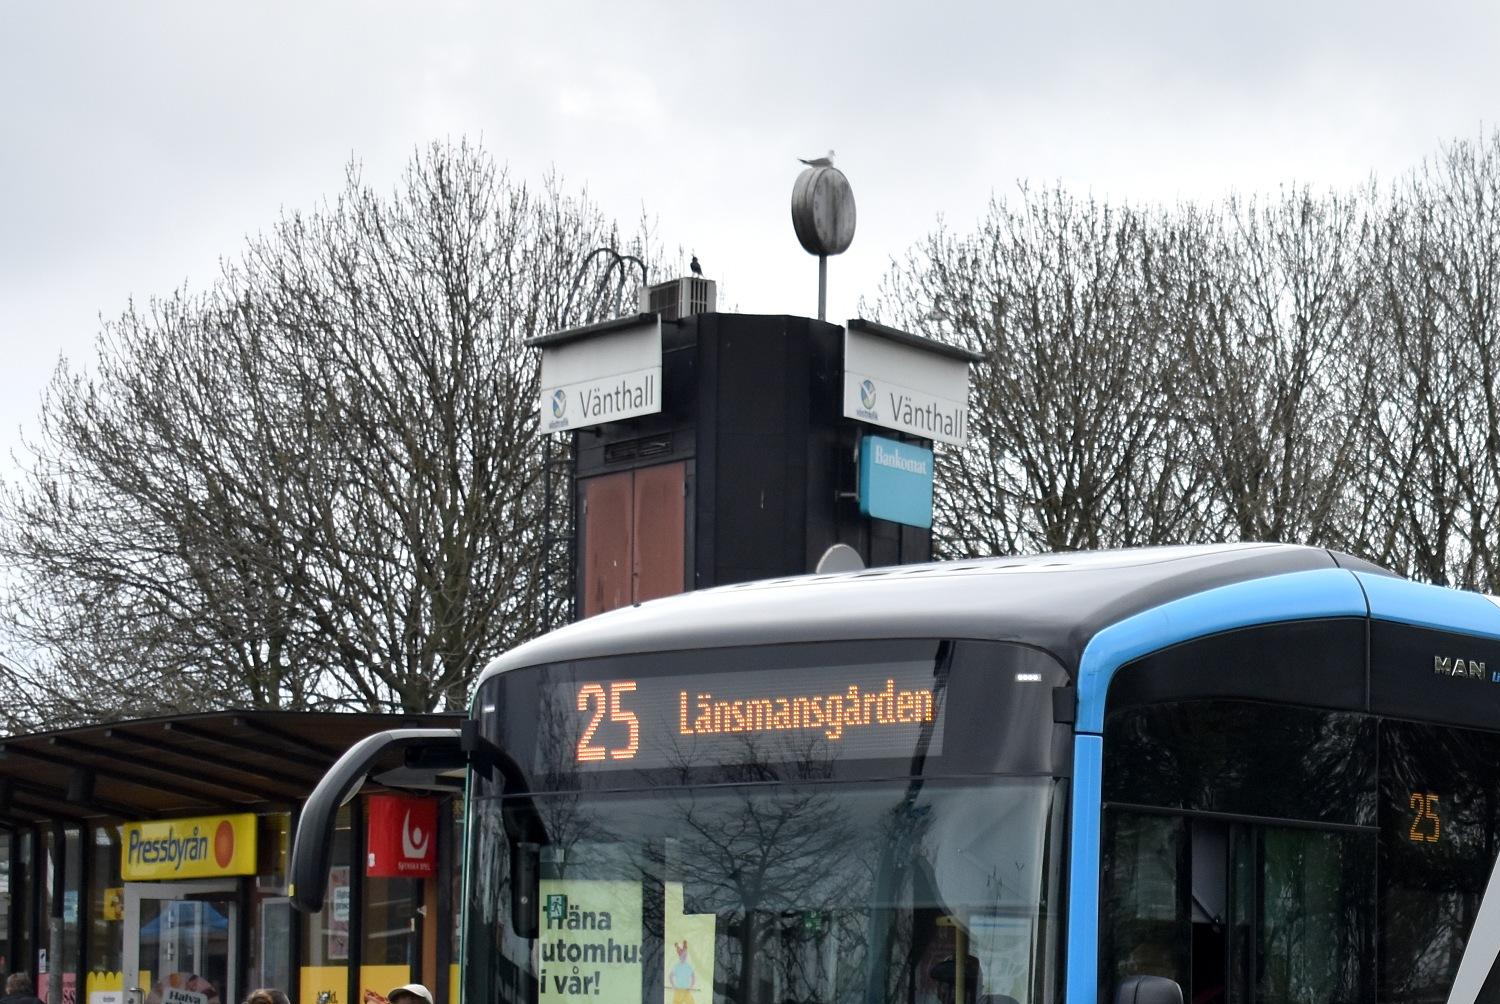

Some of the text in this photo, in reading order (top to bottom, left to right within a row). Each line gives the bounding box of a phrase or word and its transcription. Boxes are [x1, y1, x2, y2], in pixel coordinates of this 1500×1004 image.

[579, 375, 654, 418] Vänthall
[890, 392, 963, 439] Vänthall
[874, 445, 927, 475] Bankomat
[1434, 655, 1486, 680] MAN
[577, 680, 639, 761] 25
[679, 679, 933, 740] Länsmansgården
[1410, 793, 1440, 842] 25
[128, 826, 209, 871] Pressbyrån
[543, 904, 612, 930] äna
[169, 991, 201, 1004] Halva
[540, 965, 600, 995] i vår!
